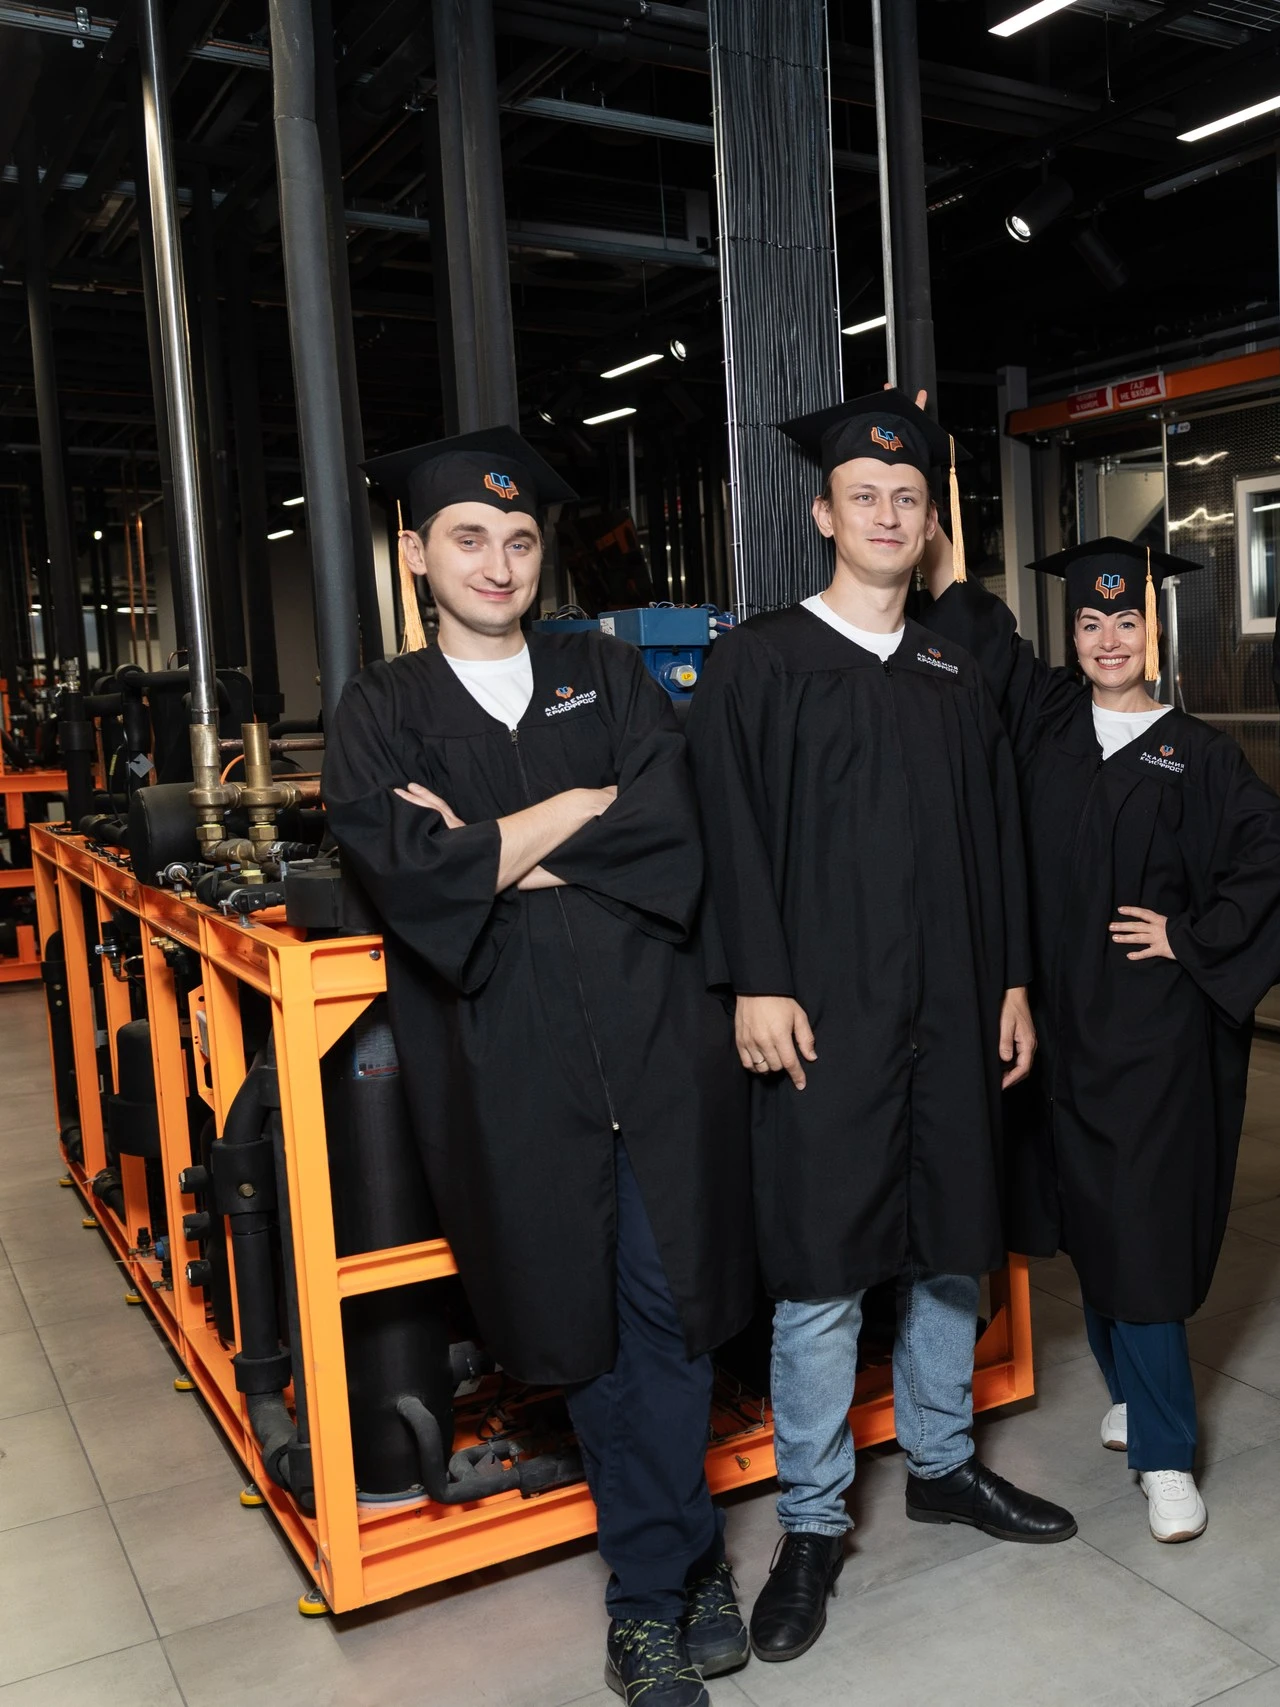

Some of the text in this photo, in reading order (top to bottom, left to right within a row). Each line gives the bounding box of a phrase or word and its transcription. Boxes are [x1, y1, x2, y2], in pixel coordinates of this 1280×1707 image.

[544, 690, 597, 713] АКАДЕМИЯ
[545, 694, 598, 717] КРИОФРОСТ
[1140, 756, 1184, 774] КРИОФРОСТ
[1141, 751, 1185, 769] АКАДЕМИЯ
